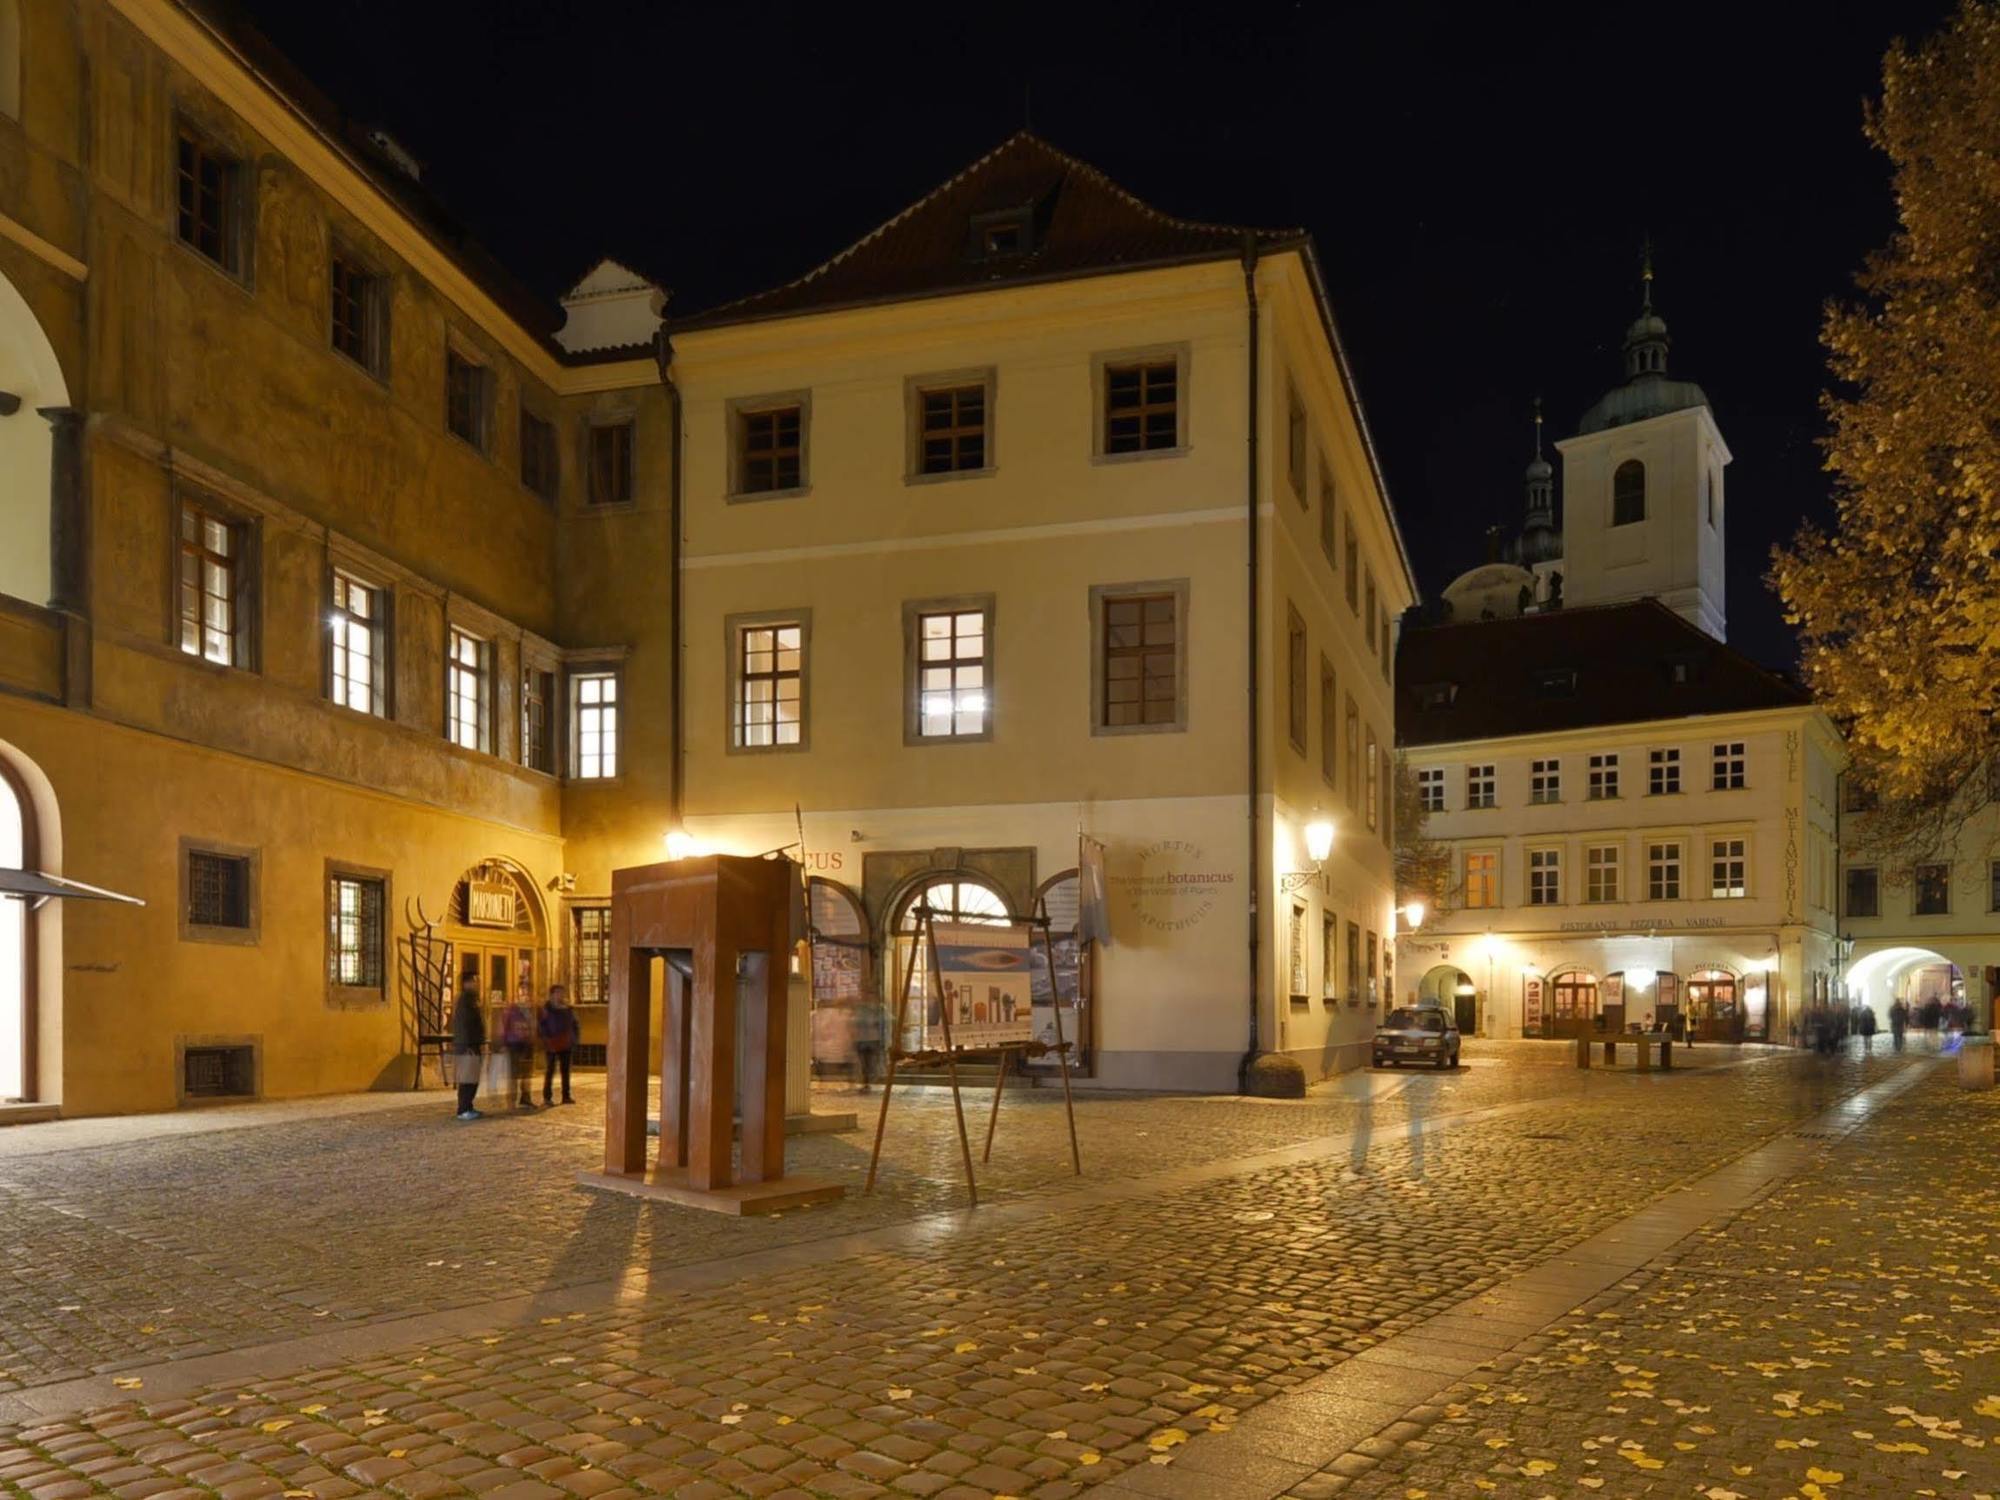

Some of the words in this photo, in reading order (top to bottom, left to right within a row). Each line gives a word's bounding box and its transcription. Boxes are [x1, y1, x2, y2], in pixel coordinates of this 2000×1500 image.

[1786, 730, 1798, 782] HOTEL
[1167, 870, 1234, 884] botanicus
[1630, 918, 1674, 928] PIZZERIA
